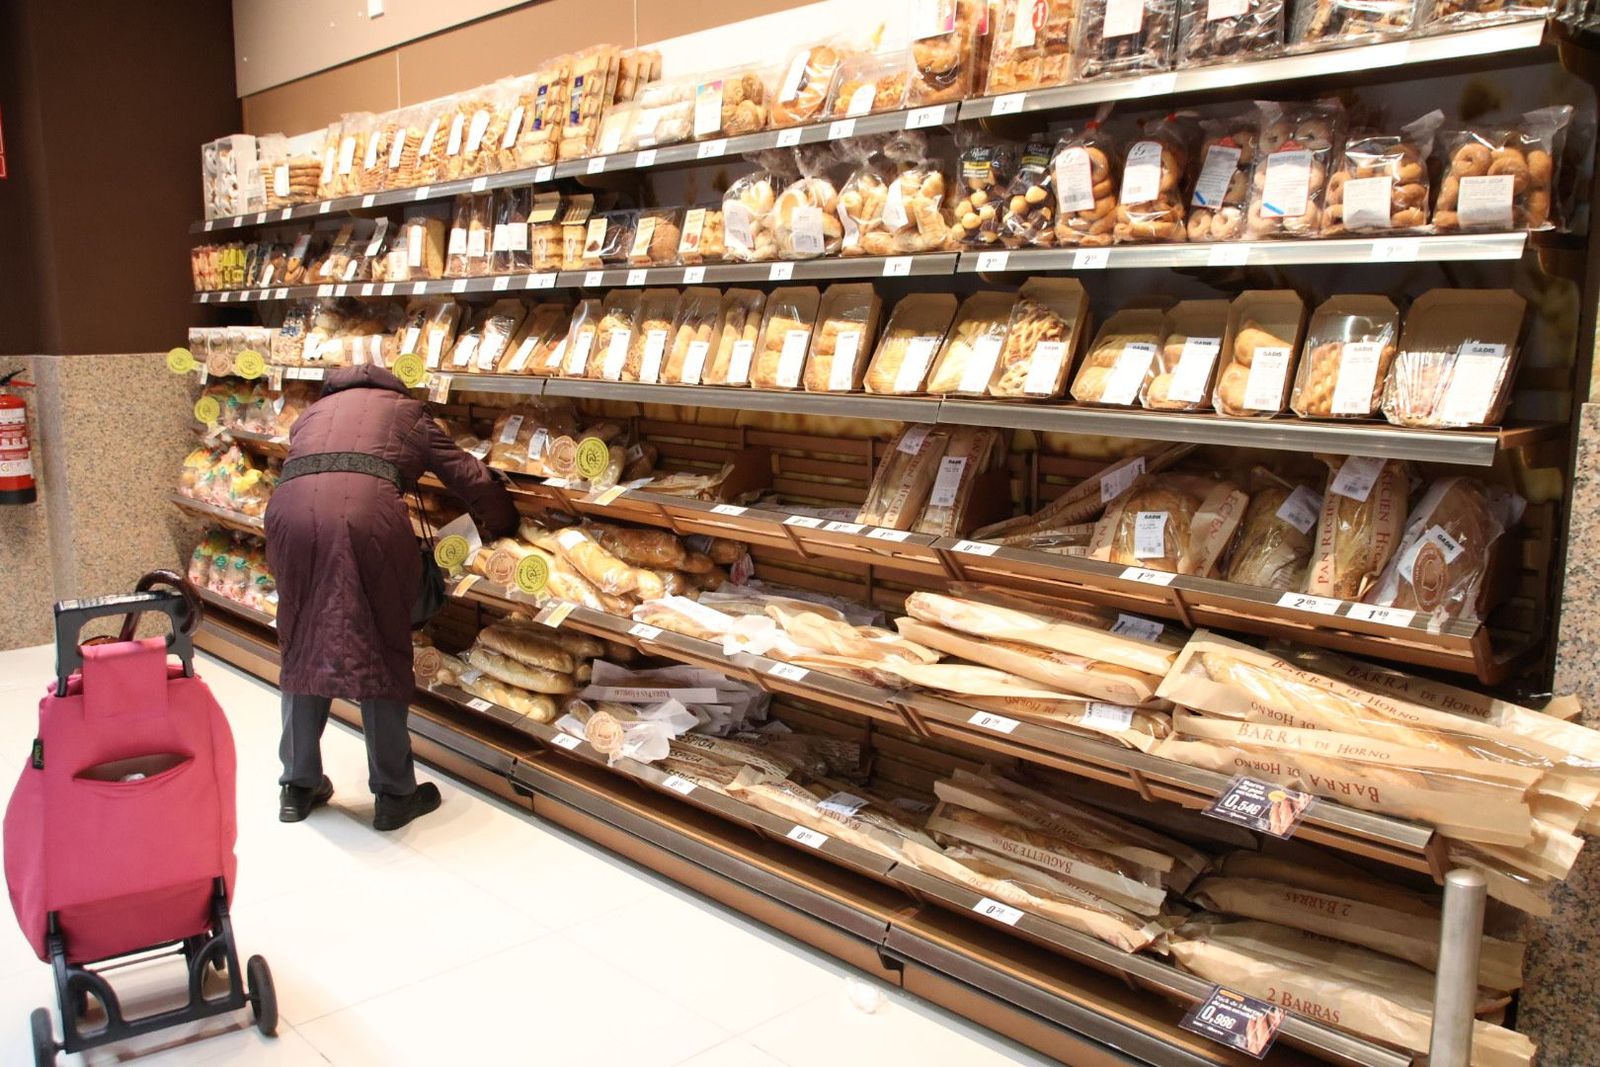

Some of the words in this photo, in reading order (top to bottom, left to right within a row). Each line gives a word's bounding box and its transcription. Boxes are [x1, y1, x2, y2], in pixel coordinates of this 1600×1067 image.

[1318, 555, 1330, 585] PAN
[1271, 659, 1335, 689] BARRA
[1367, 696, 1421, 722] HORNO
[1251, 700, 1294, 726] HORNO
[1441, 696, 1491, 719] HORNO
[1237, 724, 1303, 747] BARRA
[1314, 741, 1331, 752] DE
[1336, 743, 1391, 760] HORNO
[1234, 758, 1281, 776] HORNO
[1308, 774, 1381, 804] BARRA
[1021, 848, 1073, 874] BAGUETTE
[1286, 892, 1340, 914] BARRAS
[1342, 905, 1352, 917] 2
[1266, 988, 1277, 1002] 2
[1281, 990, 1340, 1023] BARRAS
